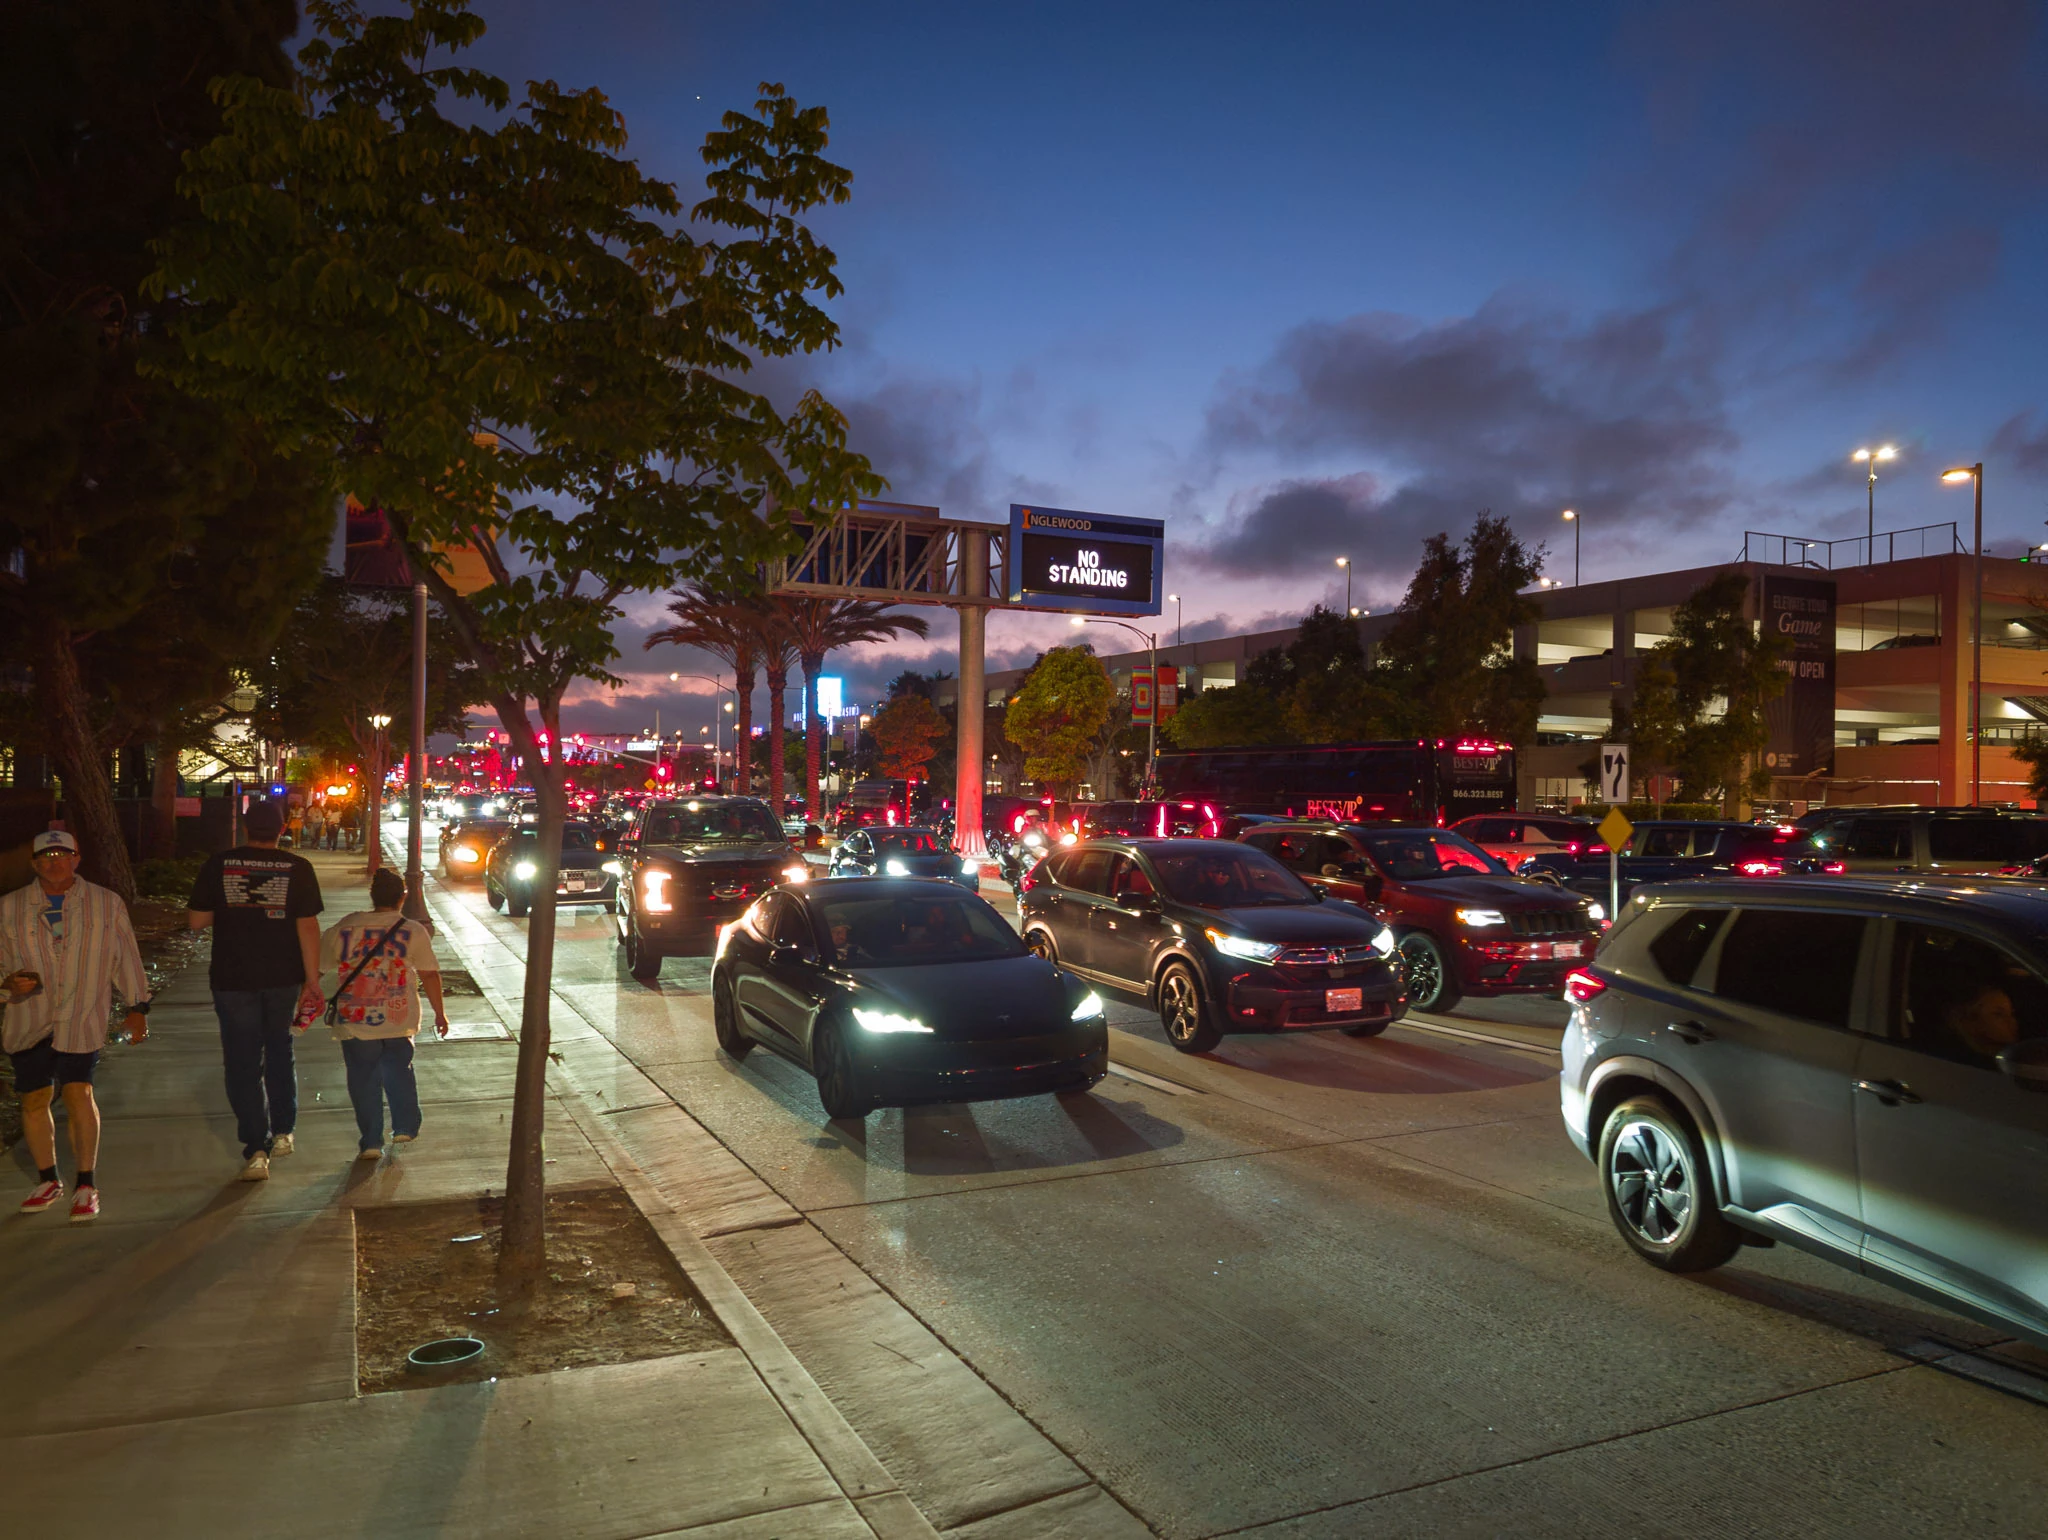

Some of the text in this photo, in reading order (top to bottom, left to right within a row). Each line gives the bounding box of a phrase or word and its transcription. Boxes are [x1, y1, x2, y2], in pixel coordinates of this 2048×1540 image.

[1021, 508, 1092, 531] INGLEWOOD
[1077, 549, 1099, 568] NO
[1048, 564, 1128, 588] STANDING
[1778, 611, 1822, 636] Game
[1800, 660, 1825, 679] OPEN
[223, 859, 242, 867] FIFA
[243, 860, 273, 868] WORLD
